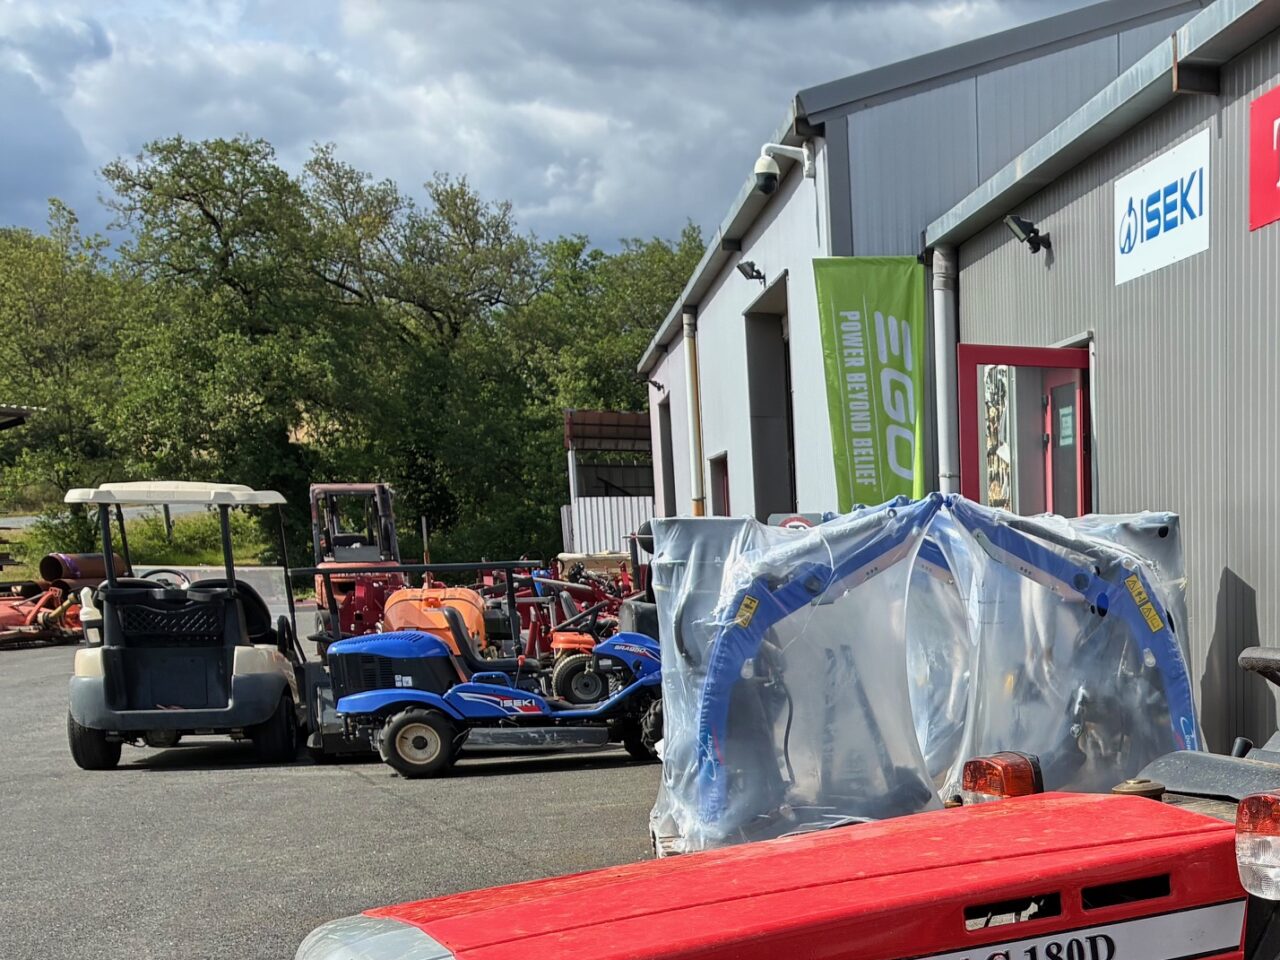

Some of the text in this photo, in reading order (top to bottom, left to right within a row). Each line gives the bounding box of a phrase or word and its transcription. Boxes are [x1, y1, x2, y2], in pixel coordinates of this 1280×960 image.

[1140, 167, 1203, 243] ISEKI
[841, 311, 876, 487] POWER BEYOND BELIEF
[874, 310, 915, 481] EGO
[500, 699, 536, 707] ISEKI
